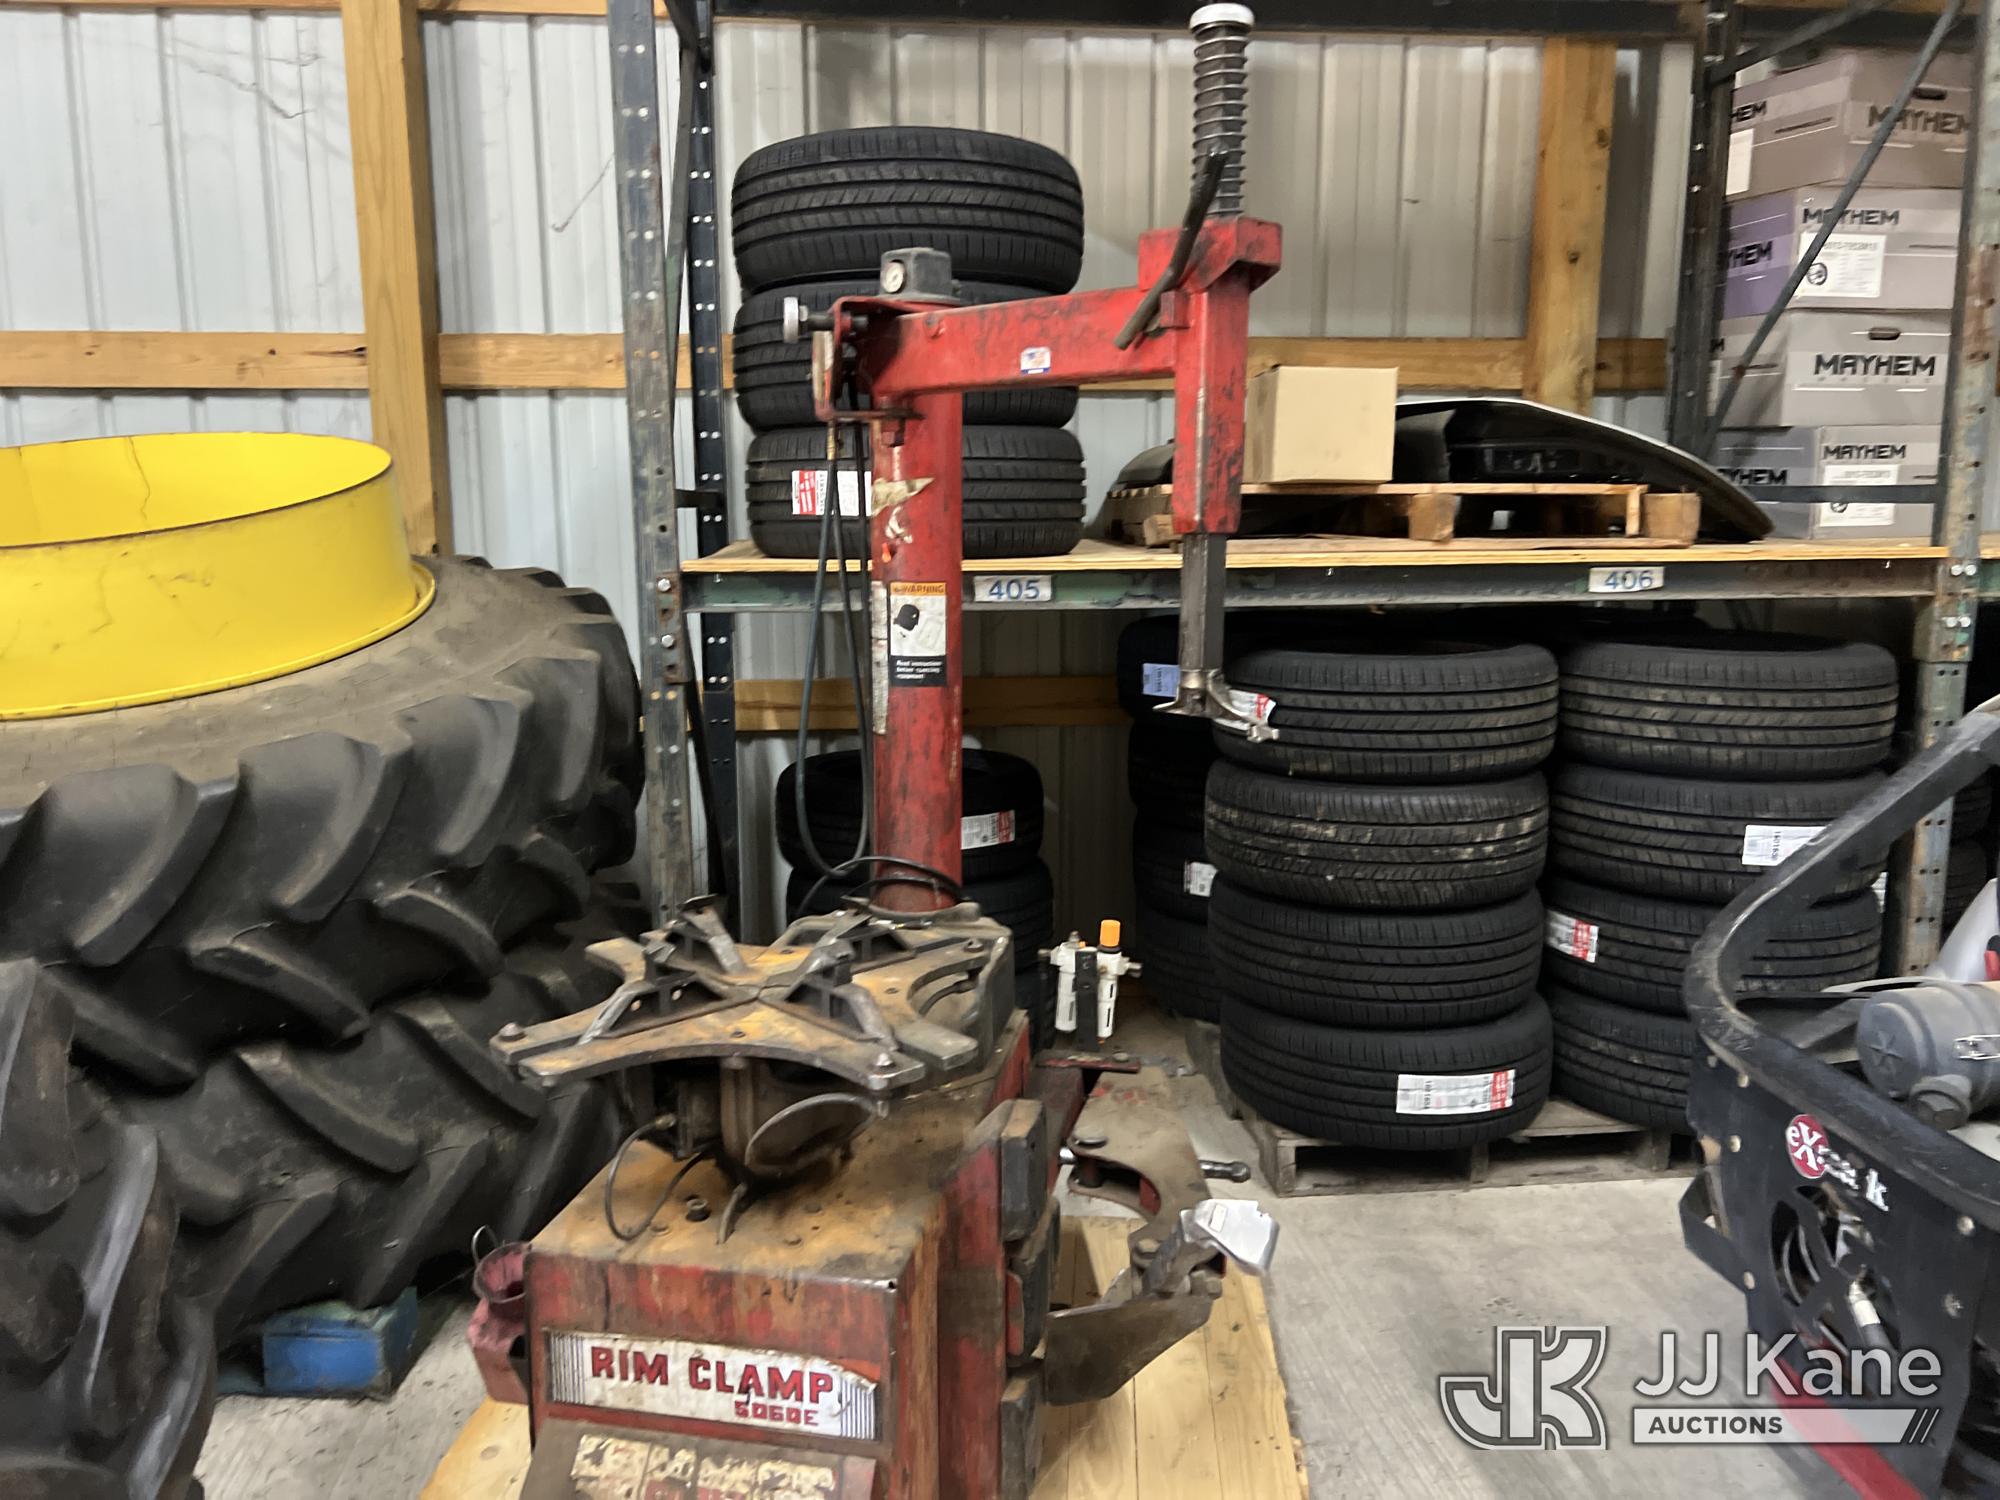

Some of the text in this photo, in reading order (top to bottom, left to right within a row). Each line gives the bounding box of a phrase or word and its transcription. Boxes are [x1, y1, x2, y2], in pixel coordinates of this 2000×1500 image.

[1813, 353, 1936, 377] MAYHEM
[1823, 444, 1907, 460] MAYHEM
[988, 578, 1041, 600] 405
[1604, 570, 1654, 590] 406
[590, 1345, 834, 1405] RIM CLAMP
[734, 1400, 820, 1428] 5060E
